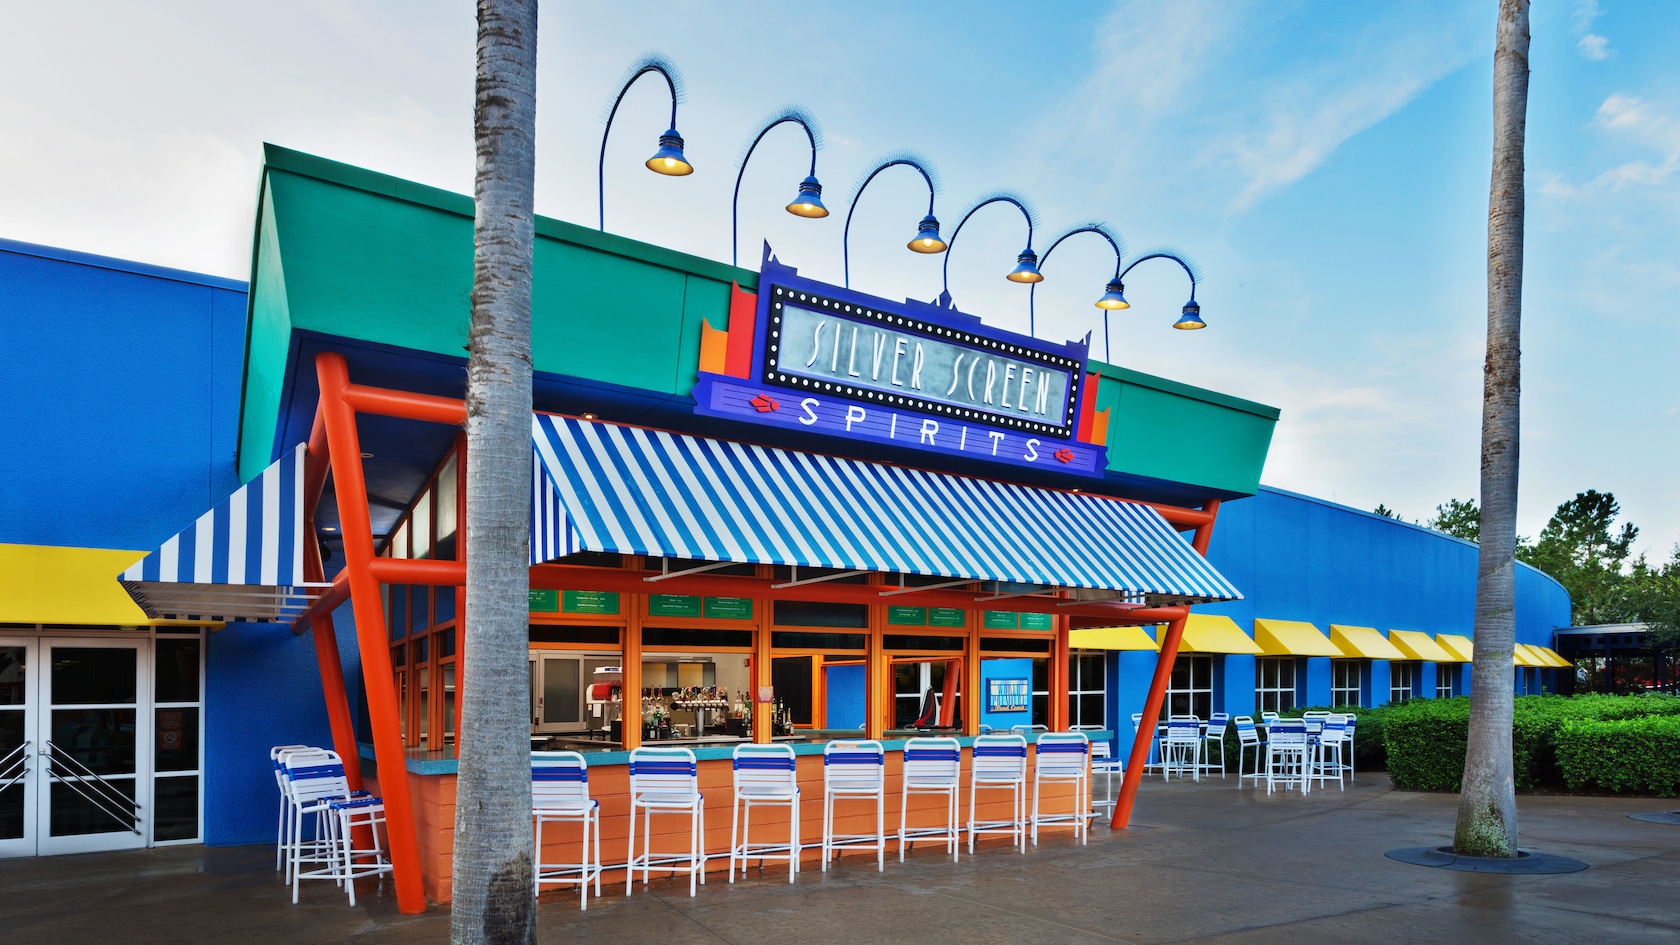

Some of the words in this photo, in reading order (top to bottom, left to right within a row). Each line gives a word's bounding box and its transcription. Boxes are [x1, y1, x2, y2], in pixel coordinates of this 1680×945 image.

[806, 320, 924, 390] SILVER
[947, 353, 1050, 415] SCREEN
[799, 398, 1040, 462] SPIRITS
